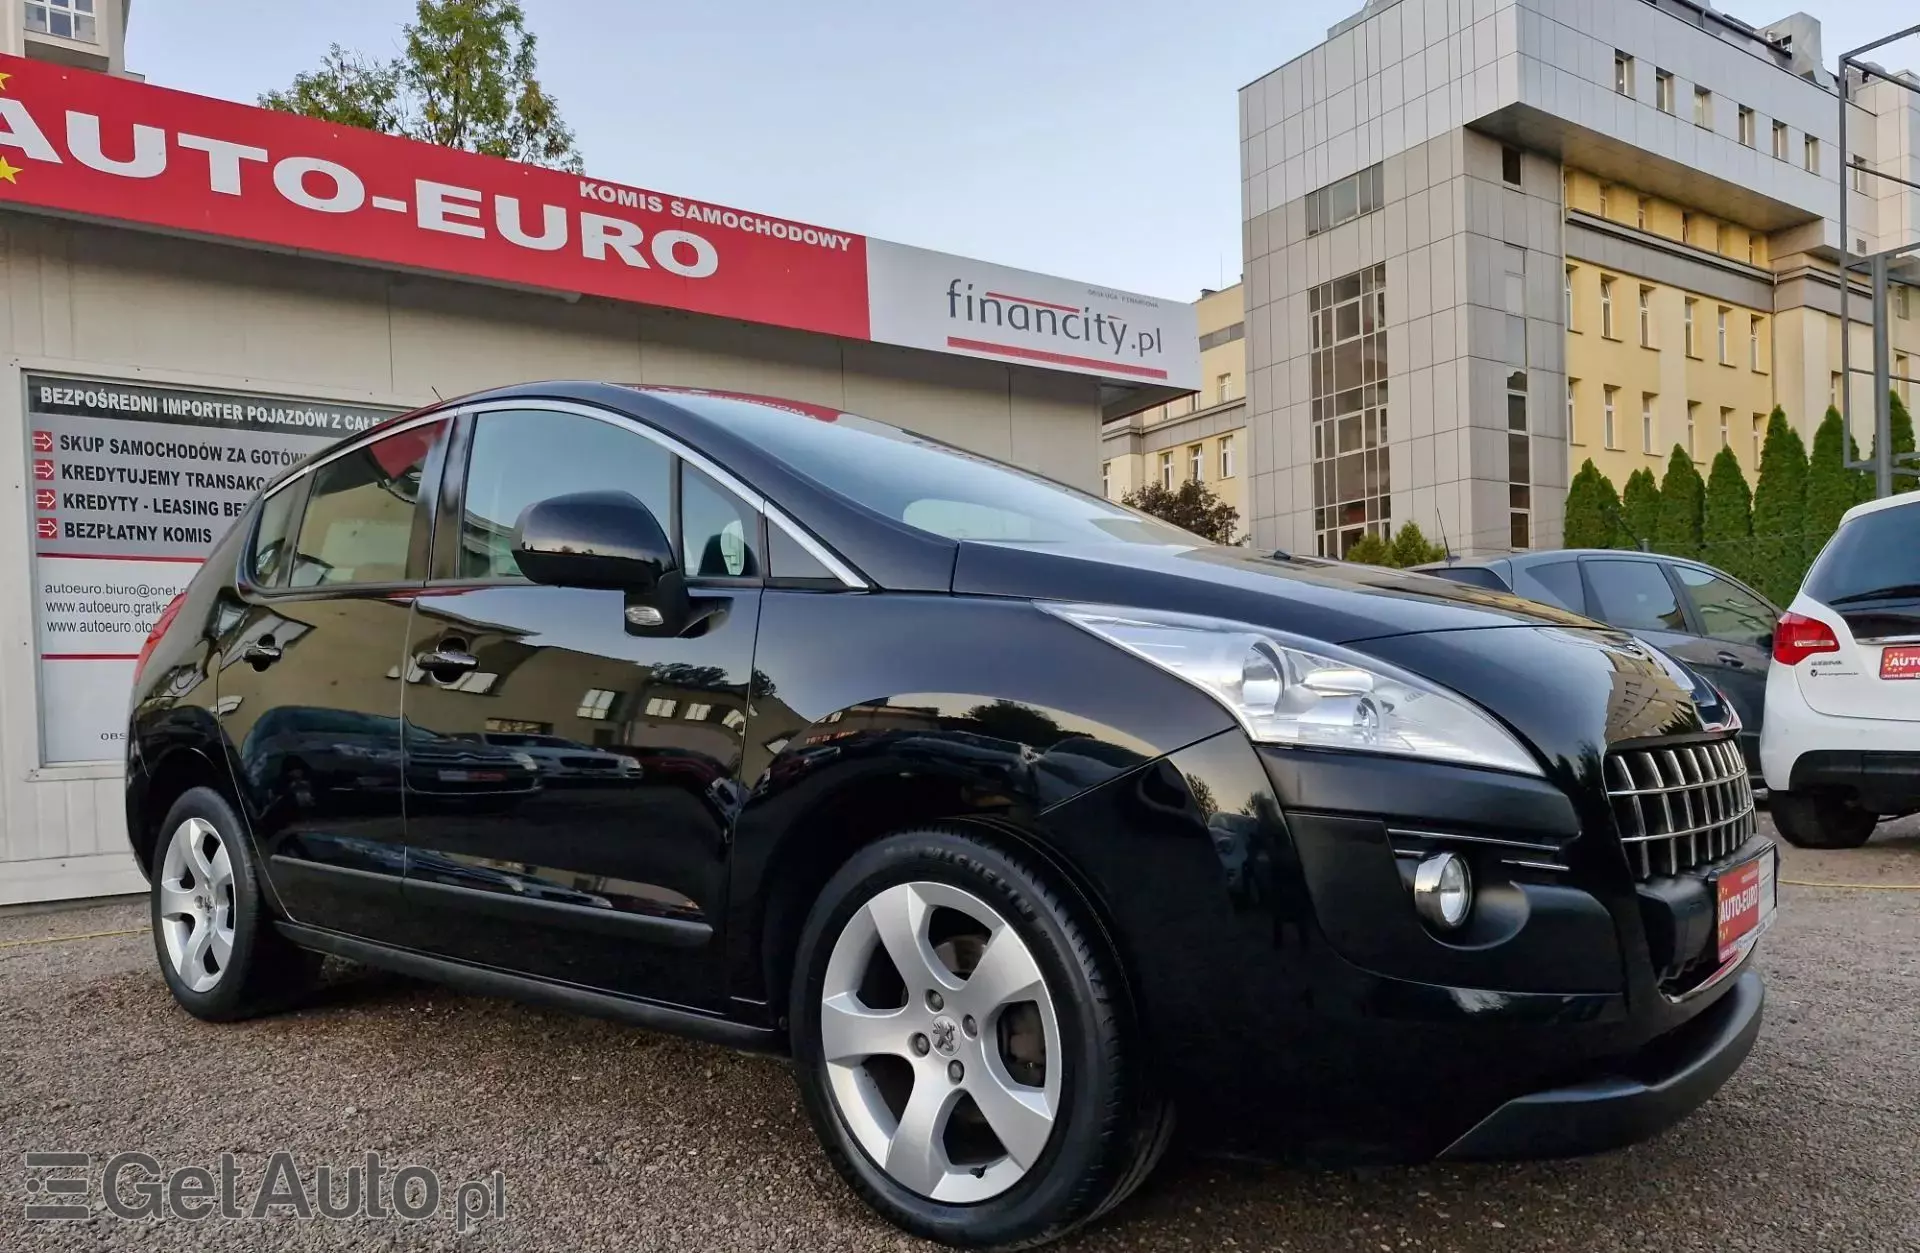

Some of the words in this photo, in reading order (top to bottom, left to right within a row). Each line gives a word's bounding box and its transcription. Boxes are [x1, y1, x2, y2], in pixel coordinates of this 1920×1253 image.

[580, 181, 662, 213] KOMIS
[671, 200, 851, 252] SAMOCHODOWY
[947, 278, 1162, 357] financity.pl
[40, 386, 157, 414] BEZPOŚREDNI
[163, 398, 243, 421] IMPORTER
[247, 405, 328, 428] POJAZDÓW
[331, 413, 342, 429] Z
[60, 434, 104, 453] SKUP
[110, 438, 222, 462] SAMOCHODÓW
[227, 447, 246, 463] ZA
[61, 463, 180, 487] KREDYTUJEMY
[63, 493, 139, 512] KREDYTY
[153, 498, 219, 517] LEASING
[224, 502, 248, 517] BE
[64, 521, 158, 541] BEZPŁATNY
[163, 526, 212, 543] KOMIS
[47, 620, 157, 633] www.autoeuro.oto
[1720, 883, 1758, 925] AUTO-EURO
